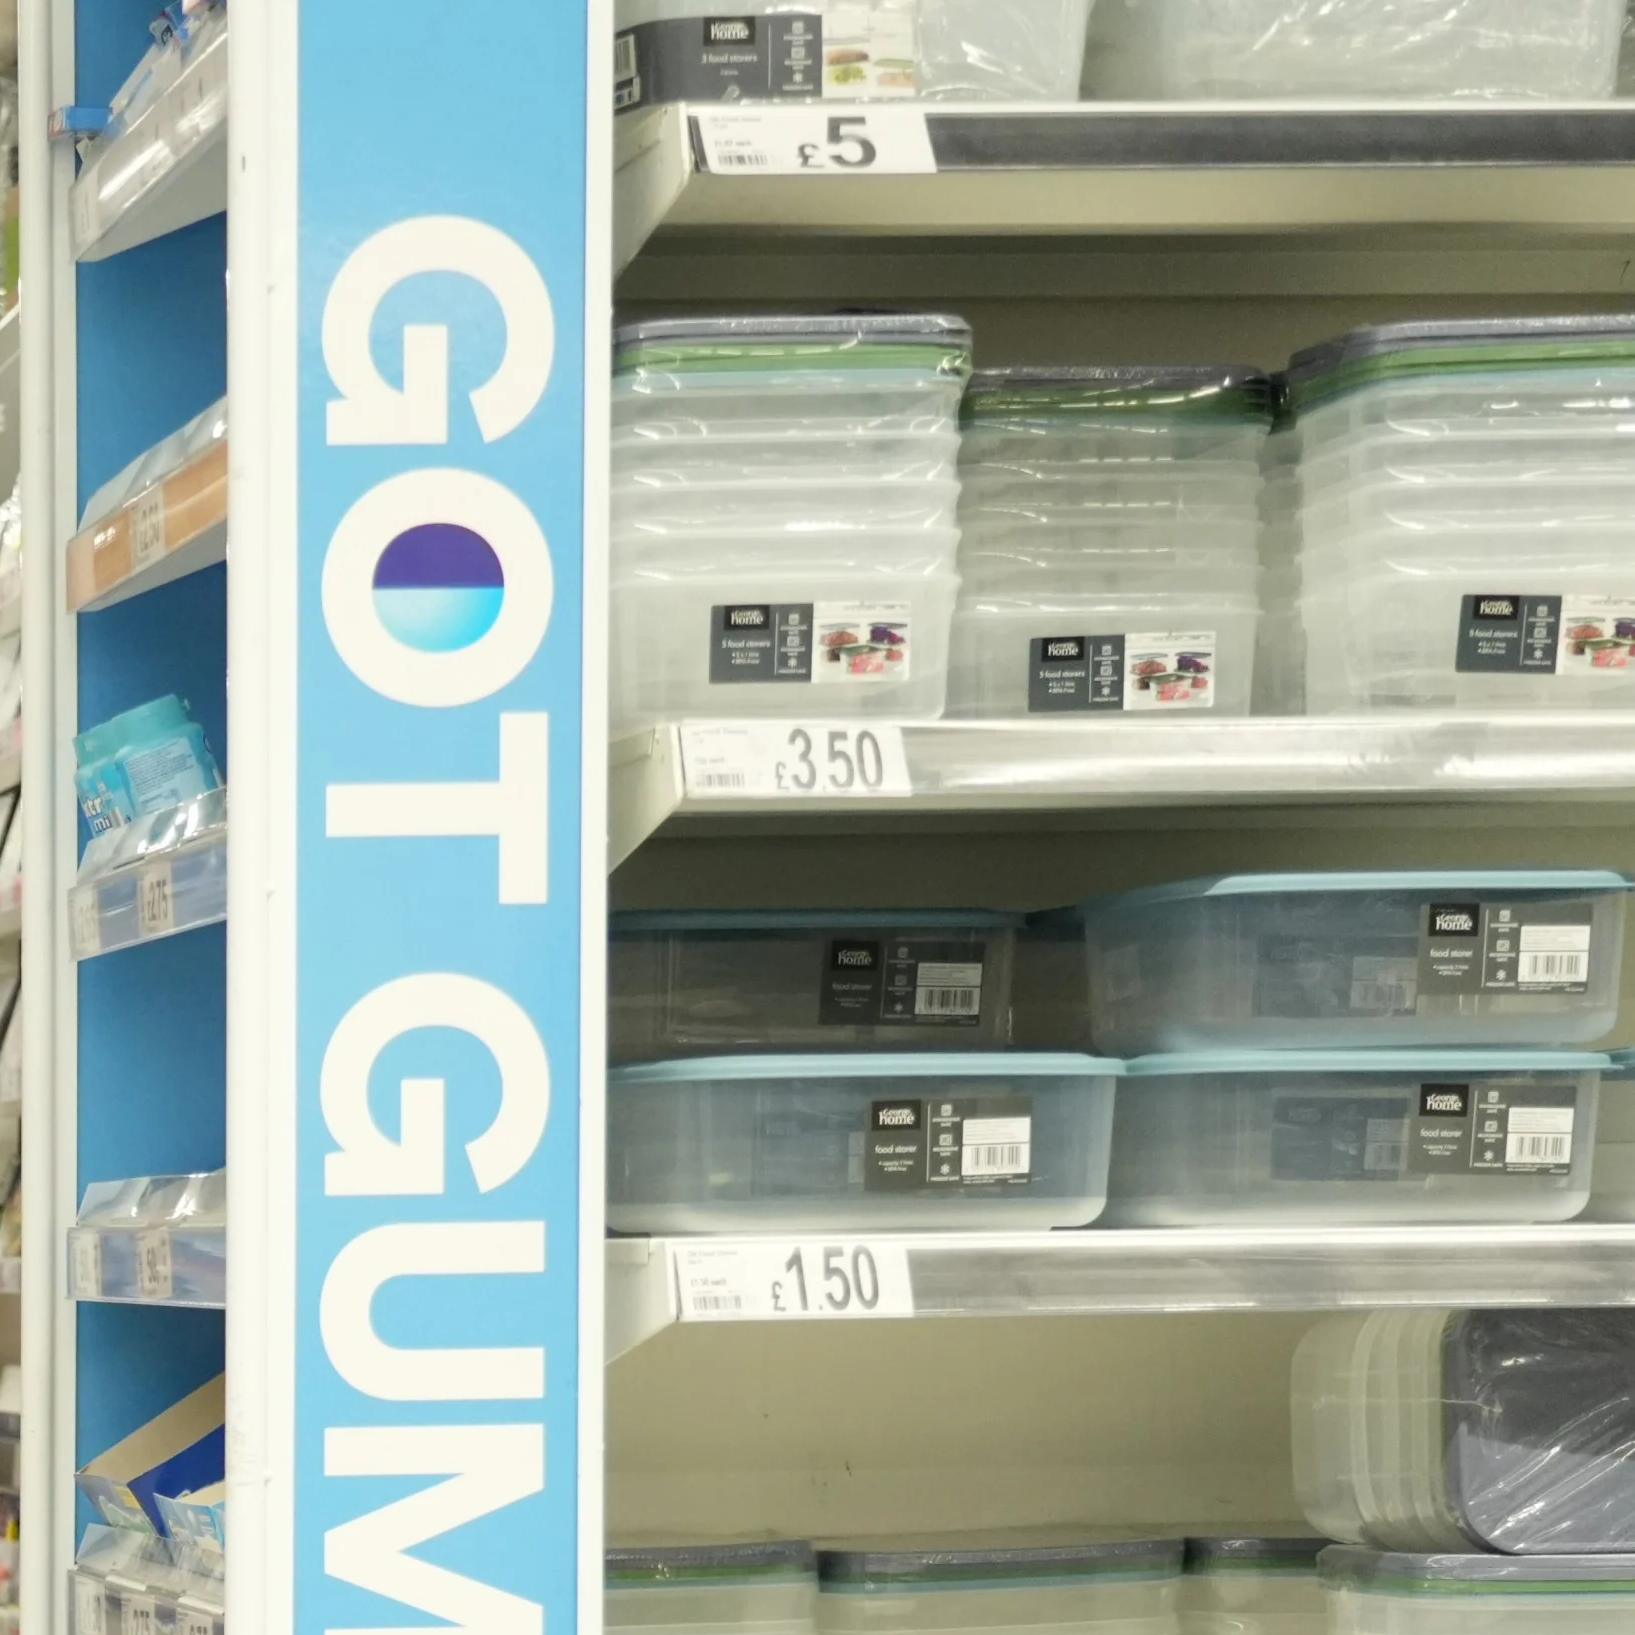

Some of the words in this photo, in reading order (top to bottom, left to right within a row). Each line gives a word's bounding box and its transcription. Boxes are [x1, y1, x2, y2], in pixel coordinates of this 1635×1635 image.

[710, 23, 750, 40] home
[796, 115, 878, 169] £5
[320, 214, 556, 905] GOT
[1479, 602, 1513, 616] home
[730, 612, 764, 626] home
[1047, 644, 1079, 657] home
[774, 727, 884, 791] £3.50
[1435, 916, 1473, 931] home
[1426, 1096, 1463, 1111] home
[878, 1111, 915, 1126] home
[771, 1244, 880, 1312] £1.50
